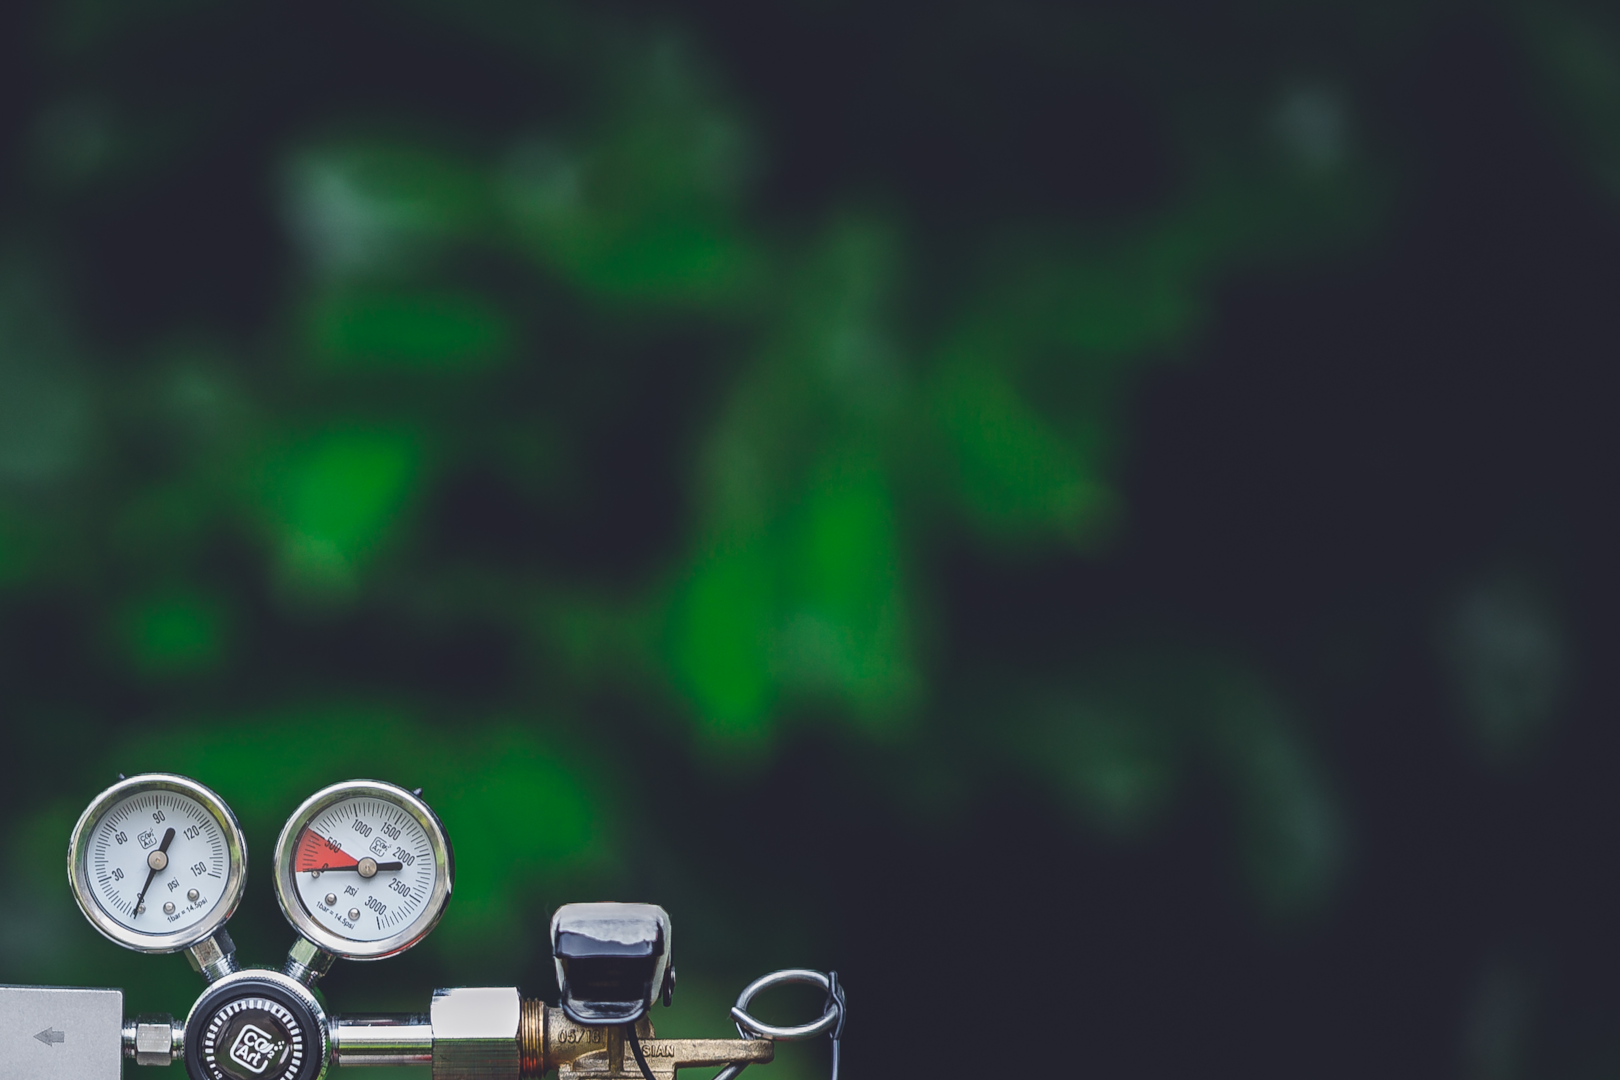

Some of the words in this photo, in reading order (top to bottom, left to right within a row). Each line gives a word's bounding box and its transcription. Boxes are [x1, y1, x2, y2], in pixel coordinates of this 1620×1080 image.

[152, 810, 166, 825] 90
[183, 825, 200, 841] 120
[351, 819, 373, 838] 1000
[380, 822, 401, 841] 1500
[115, 831, 128, 845] 60
[324, 837, 342, 854] 500
[392, 846, 415, 867] 2000
[111, 868, 124, 882] 30
[190, 861, 207, 877] 150
[167, 876, 180, 892] psi
[343, 884, 359, 897] psi
[388, 877, 411, 898] 2500
[364, 896, 387, 915] 3000
[235, 1045, 262, 1067] Art
